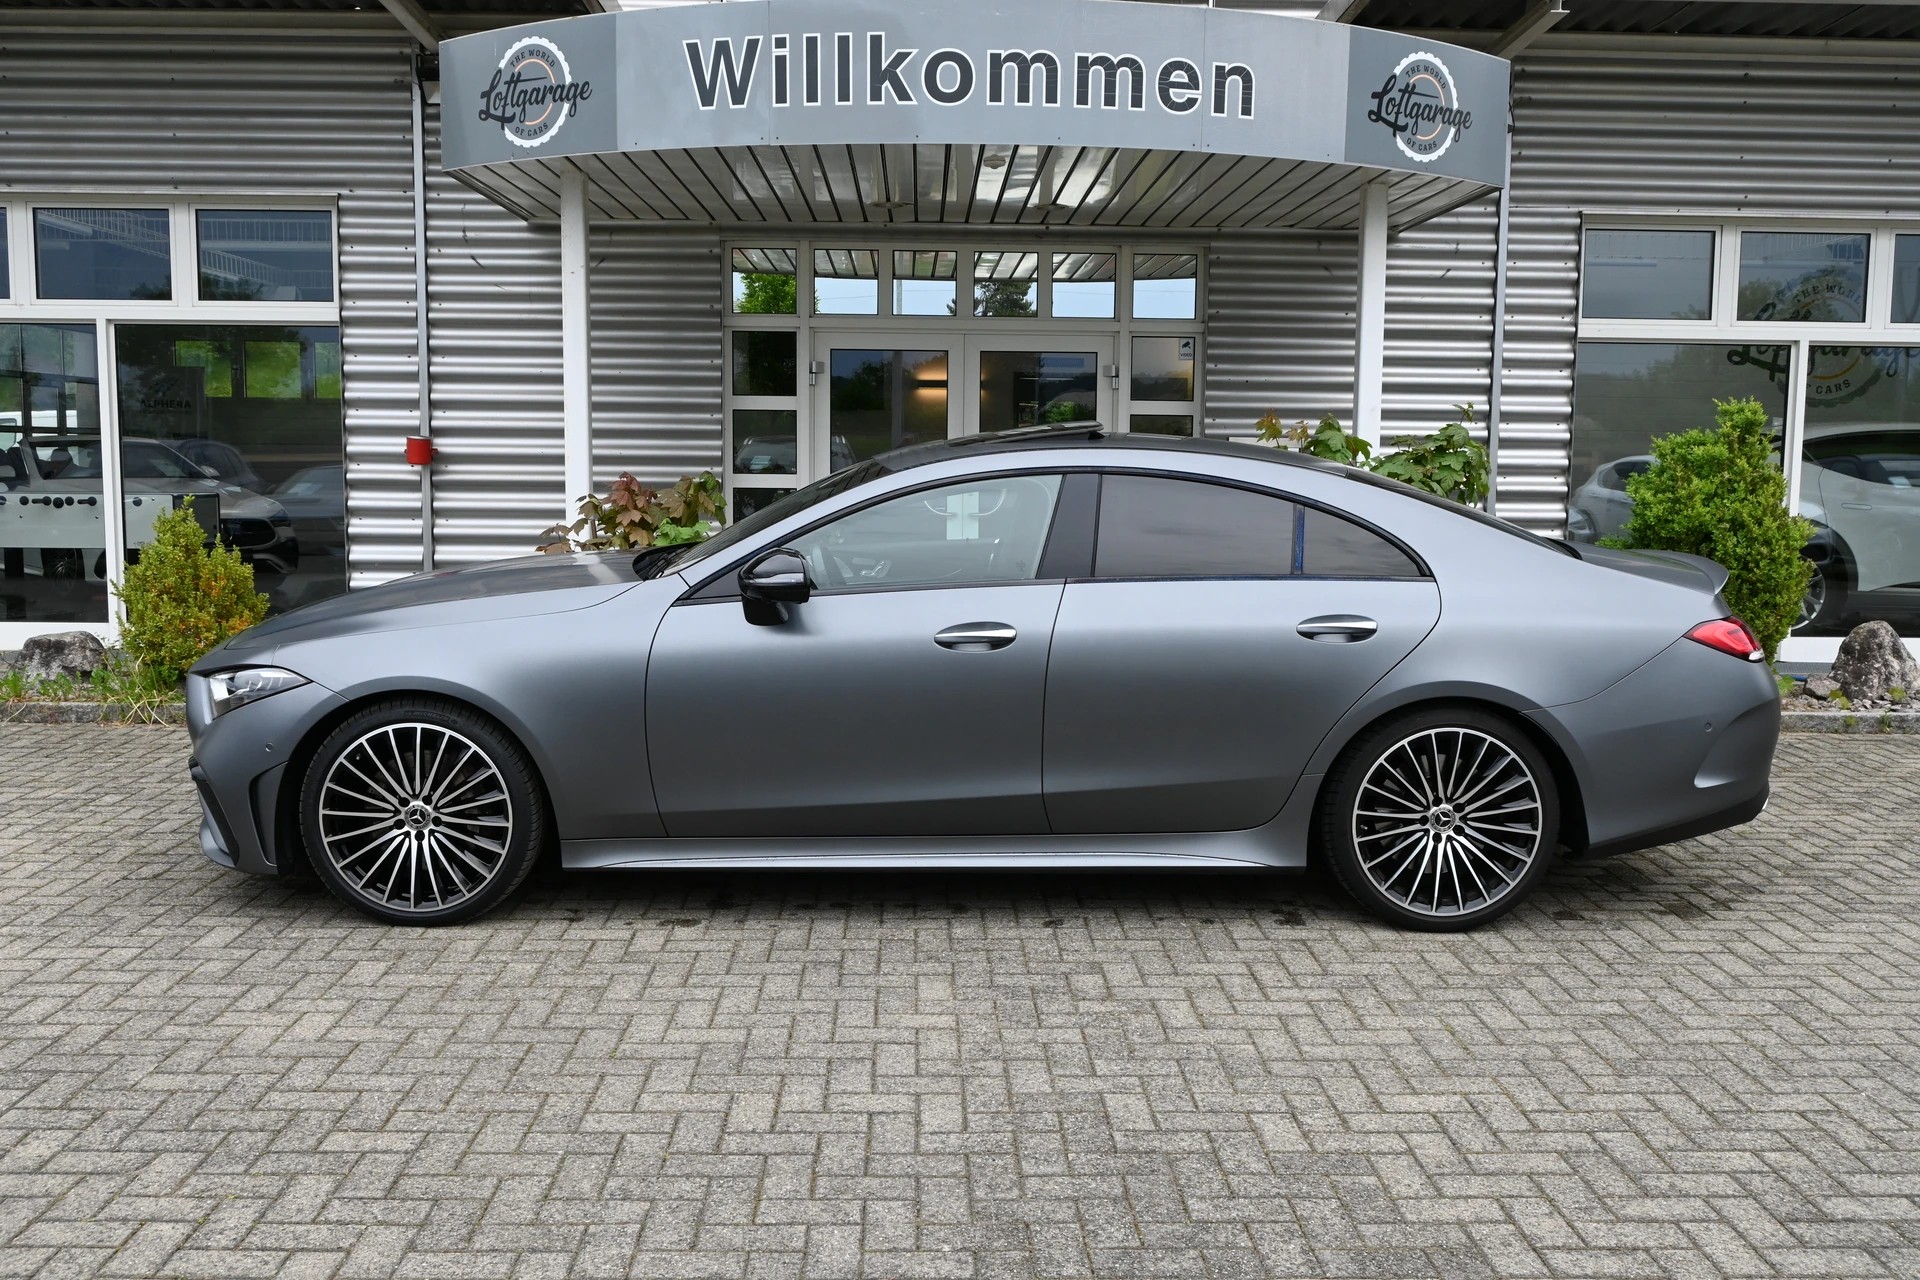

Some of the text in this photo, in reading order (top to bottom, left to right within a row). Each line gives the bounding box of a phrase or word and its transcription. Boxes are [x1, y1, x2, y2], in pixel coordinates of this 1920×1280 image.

[510, 49, 556, 67] THE WORLD
[682, 31, 1256, 119] Willkommen
[1406, 65, 1446, 89] THE WORLD
[478, 68, 592, 131] Loftgarage
[1367, 74, 1473, 142] Loftgarage
[515, 122, 548, 136] OF CARS
[1407, 137, 1437, 151] OF CARS
[1793, 283, 1862, 305] THE WORL
[1816, 379, 1851, 395] CARS
